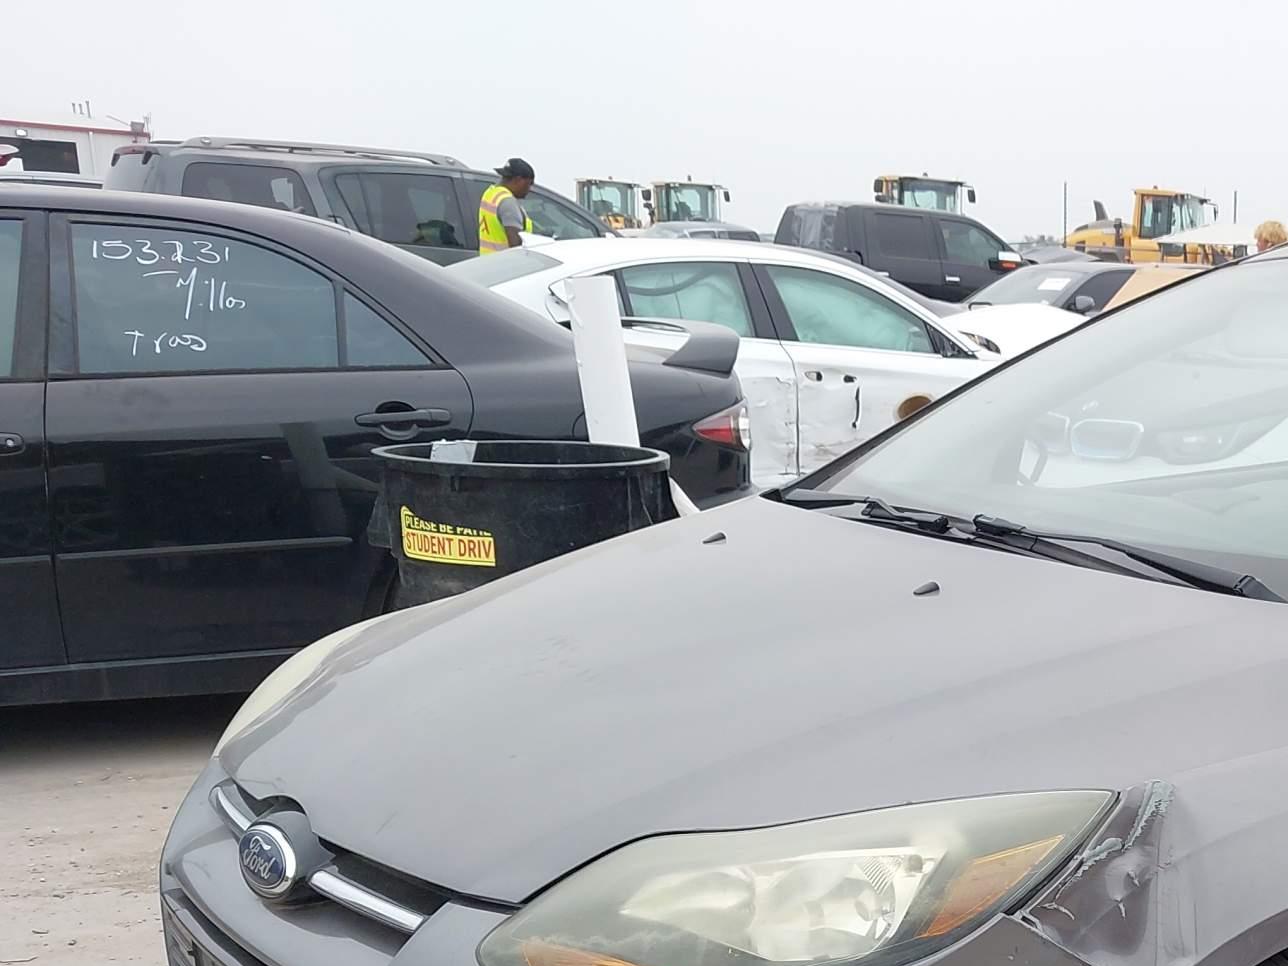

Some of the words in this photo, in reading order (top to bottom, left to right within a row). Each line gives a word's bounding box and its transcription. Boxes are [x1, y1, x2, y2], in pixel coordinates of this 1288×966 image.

[405, 515, 438, 531] PLEASE
[439, 523, 455, 533] BE
[406, 532, 453, 556] STUDENT
[458, 540, 492, 559] DRIV
[243, 835, 277, 879] Ford
